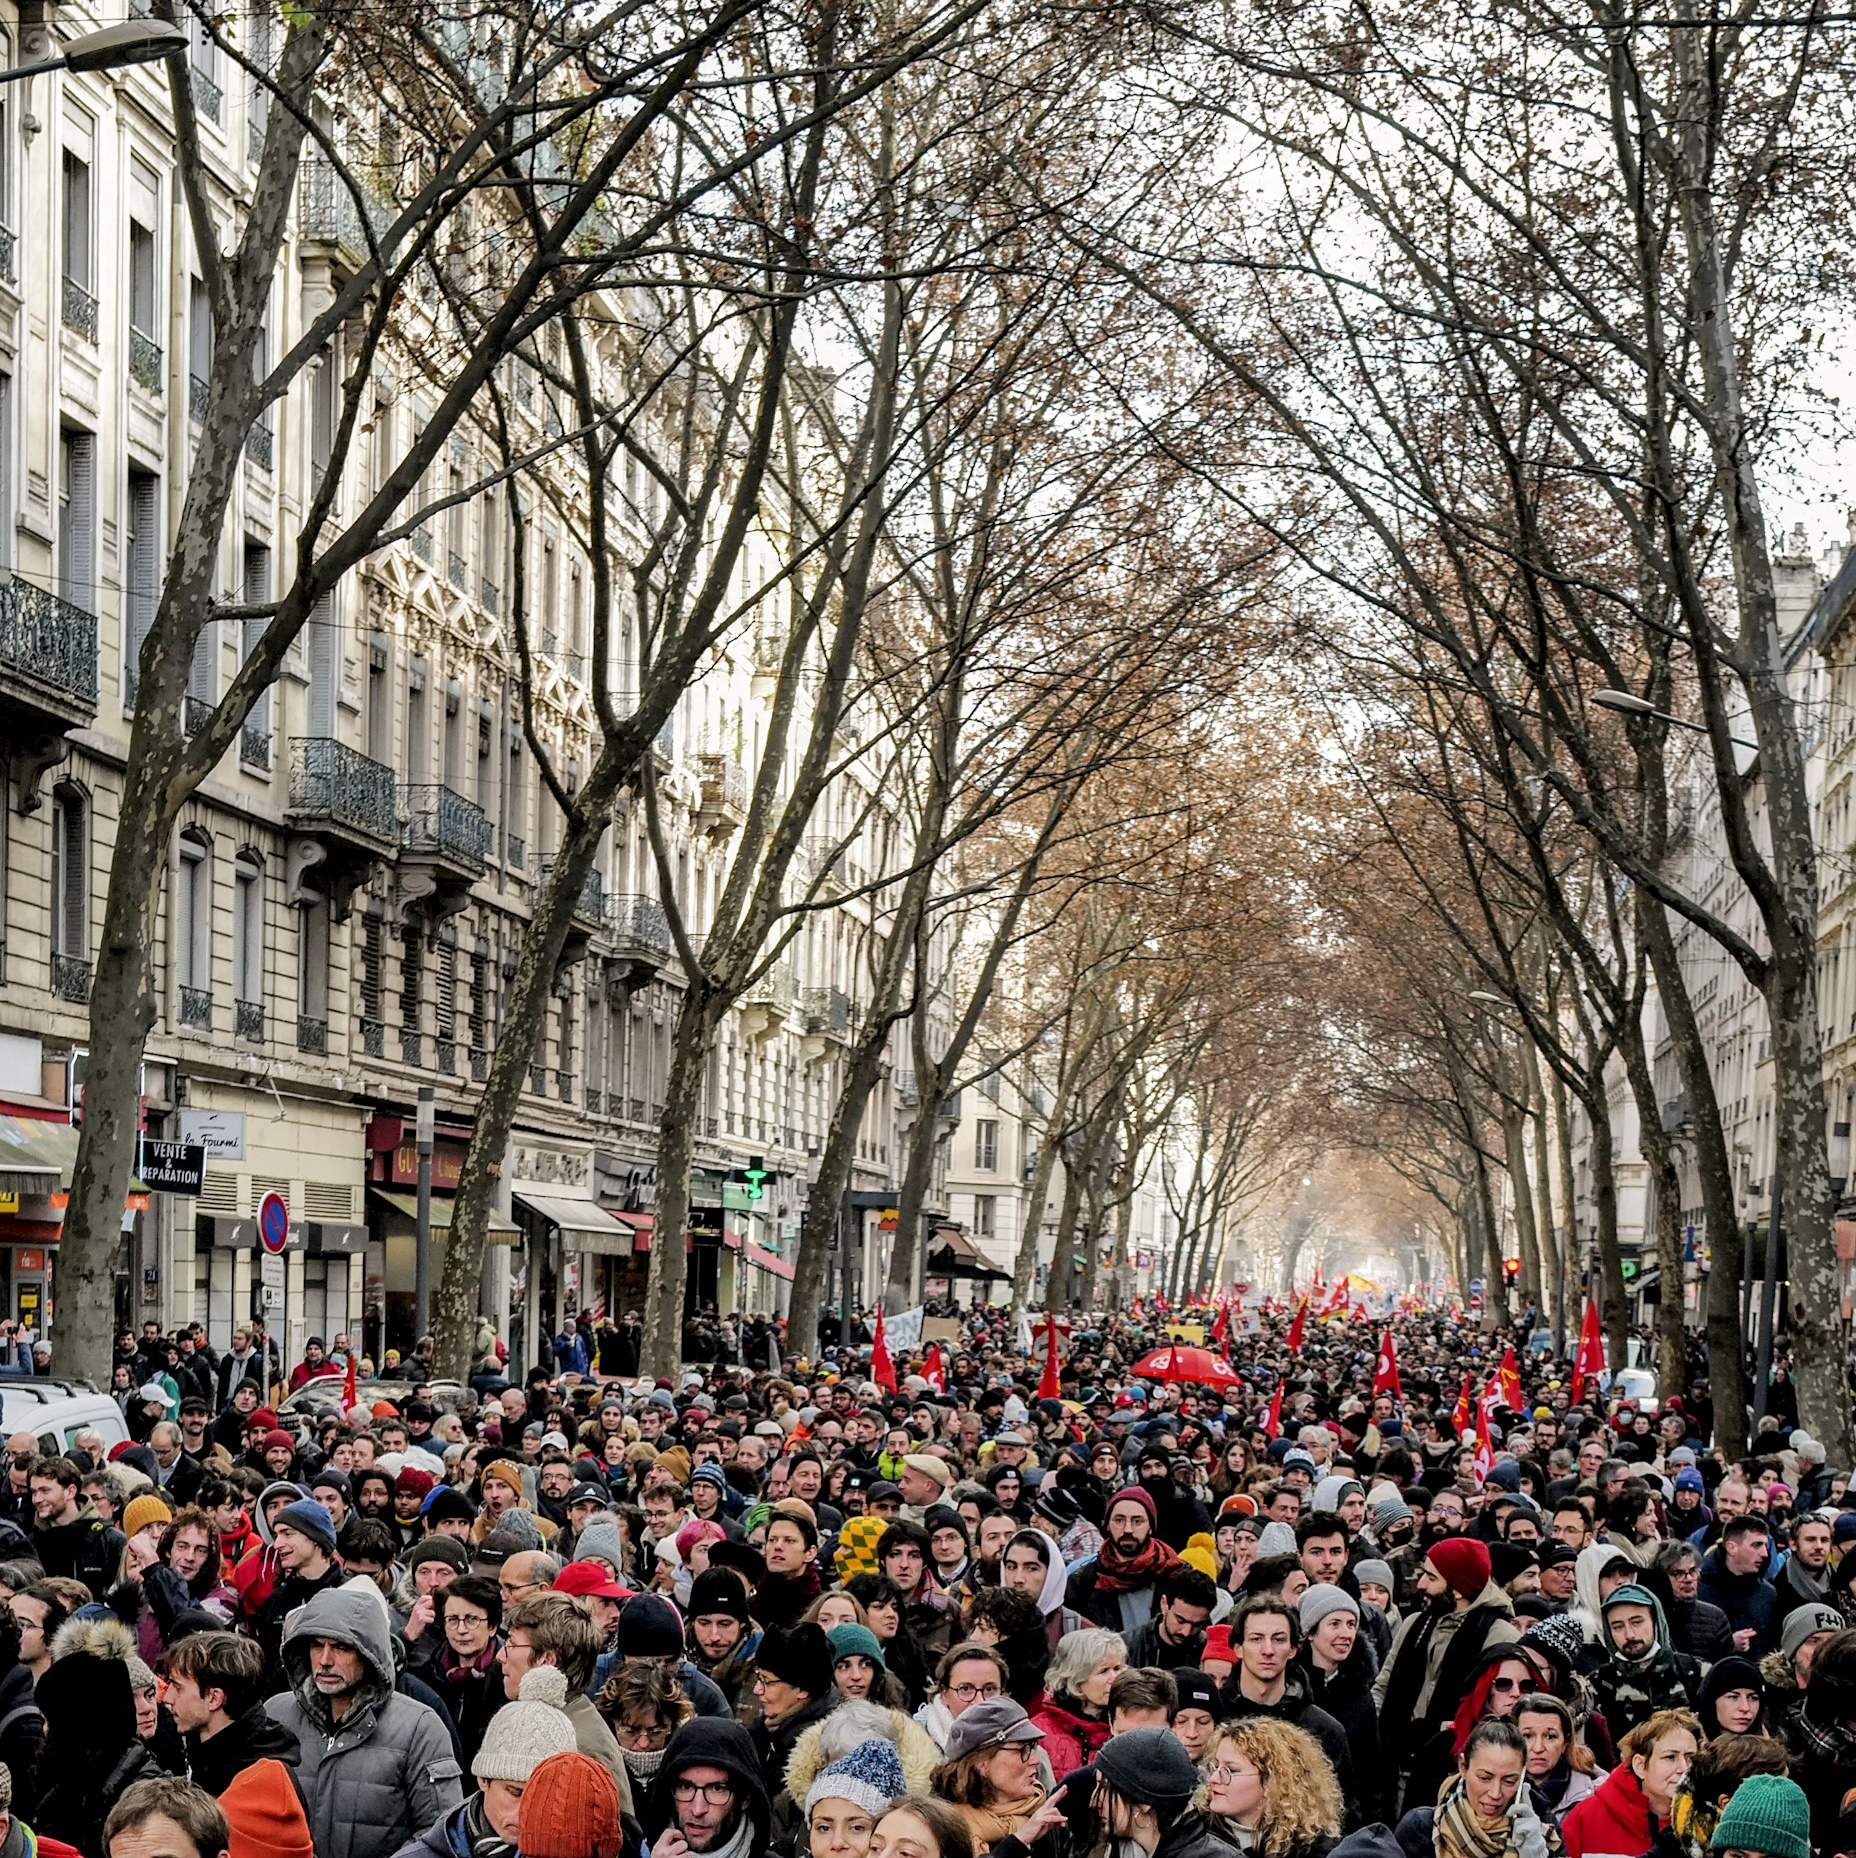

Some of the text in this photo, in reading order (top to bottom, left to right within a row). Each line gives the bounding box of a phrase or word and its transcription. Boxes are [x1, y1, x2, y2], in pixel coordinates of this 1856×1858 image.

[200, 1134, 239, 1149] Fourmi
[153, 1142, 187, 1160] VENTE
[165, 1158, 173, 1169] &
[143, 1167, 198, 1185] REPARATION
